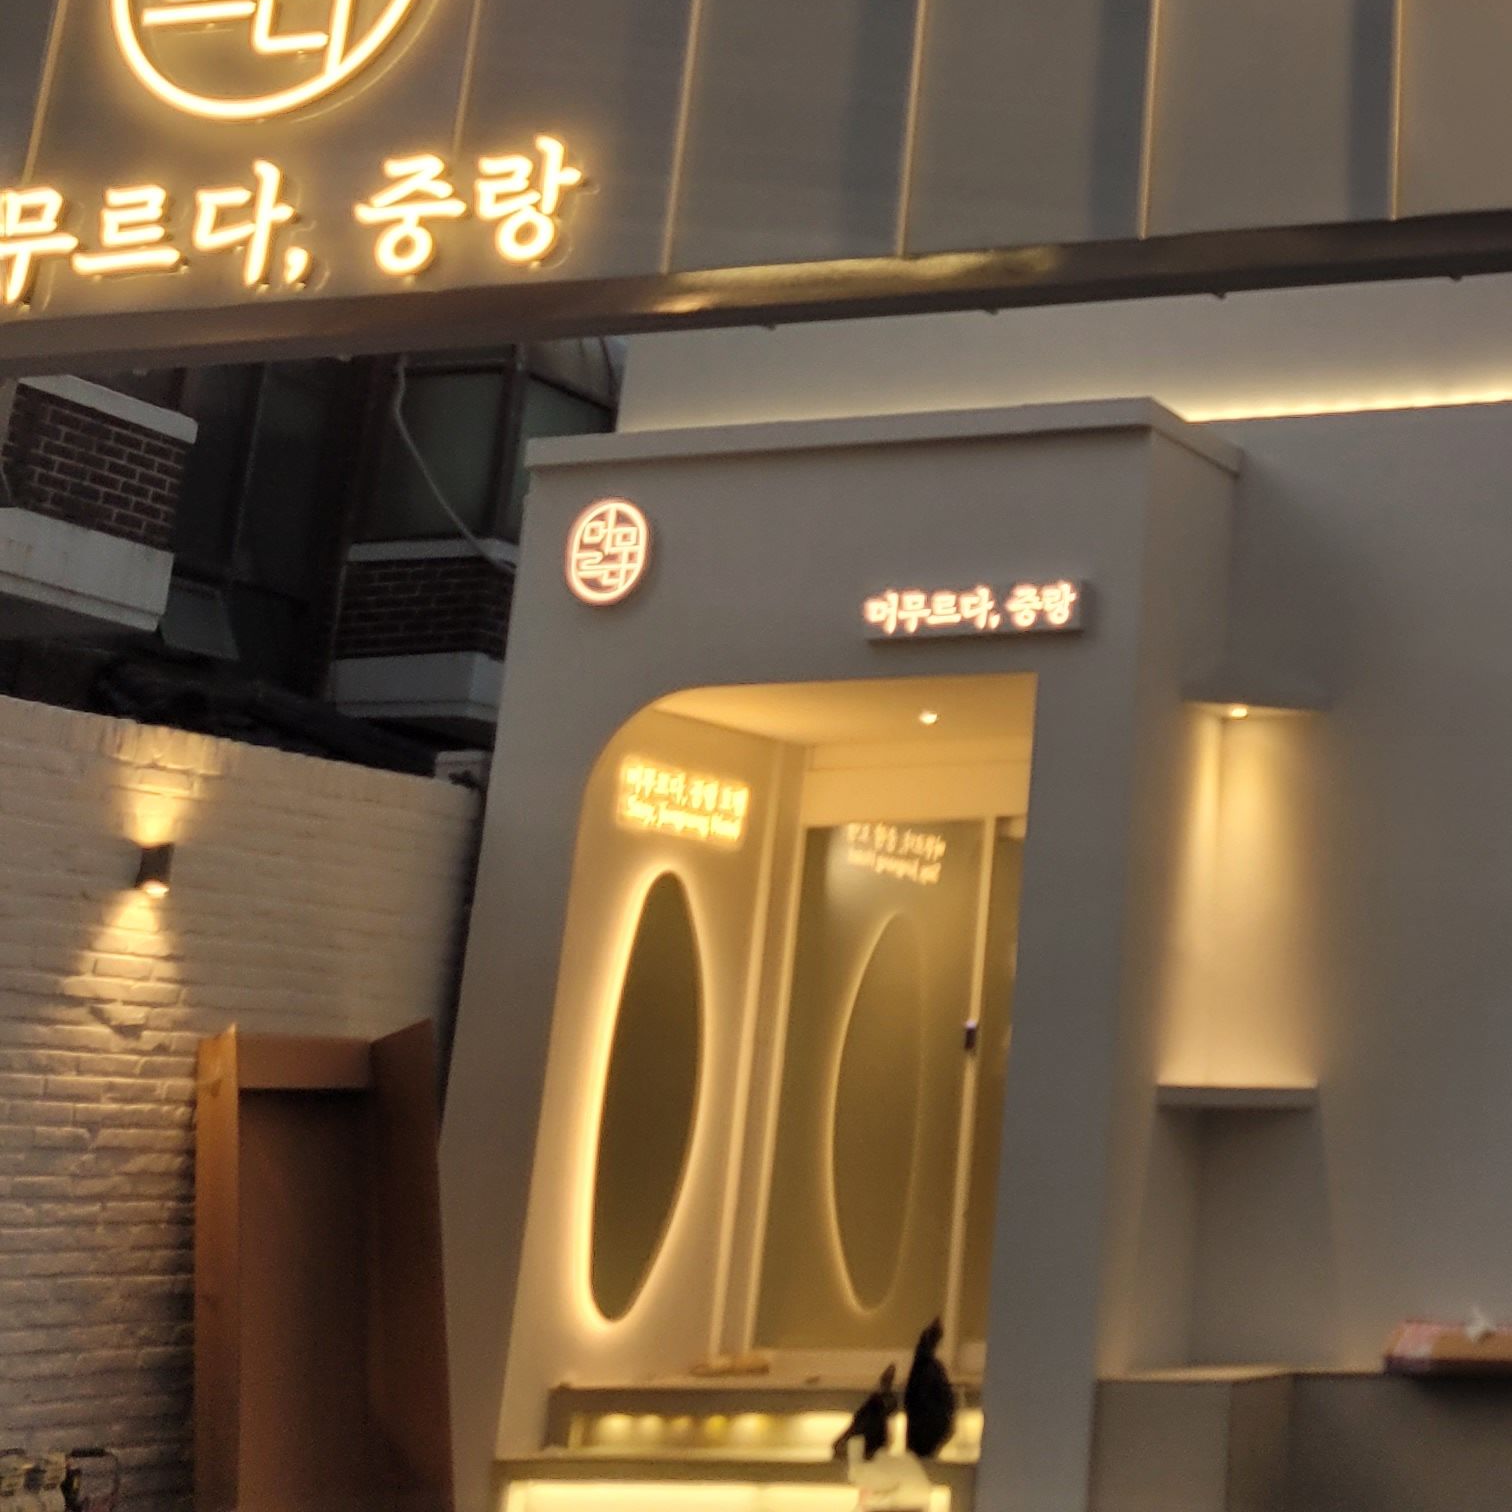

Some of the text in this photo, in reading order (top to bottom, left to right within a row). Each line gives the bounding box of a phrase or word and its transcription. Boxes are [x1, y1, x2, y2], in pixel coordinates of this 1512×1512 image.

[354, 134, 584, 276] 중랑
[863, 579, 1078, 635] 머무르다, 중랑
